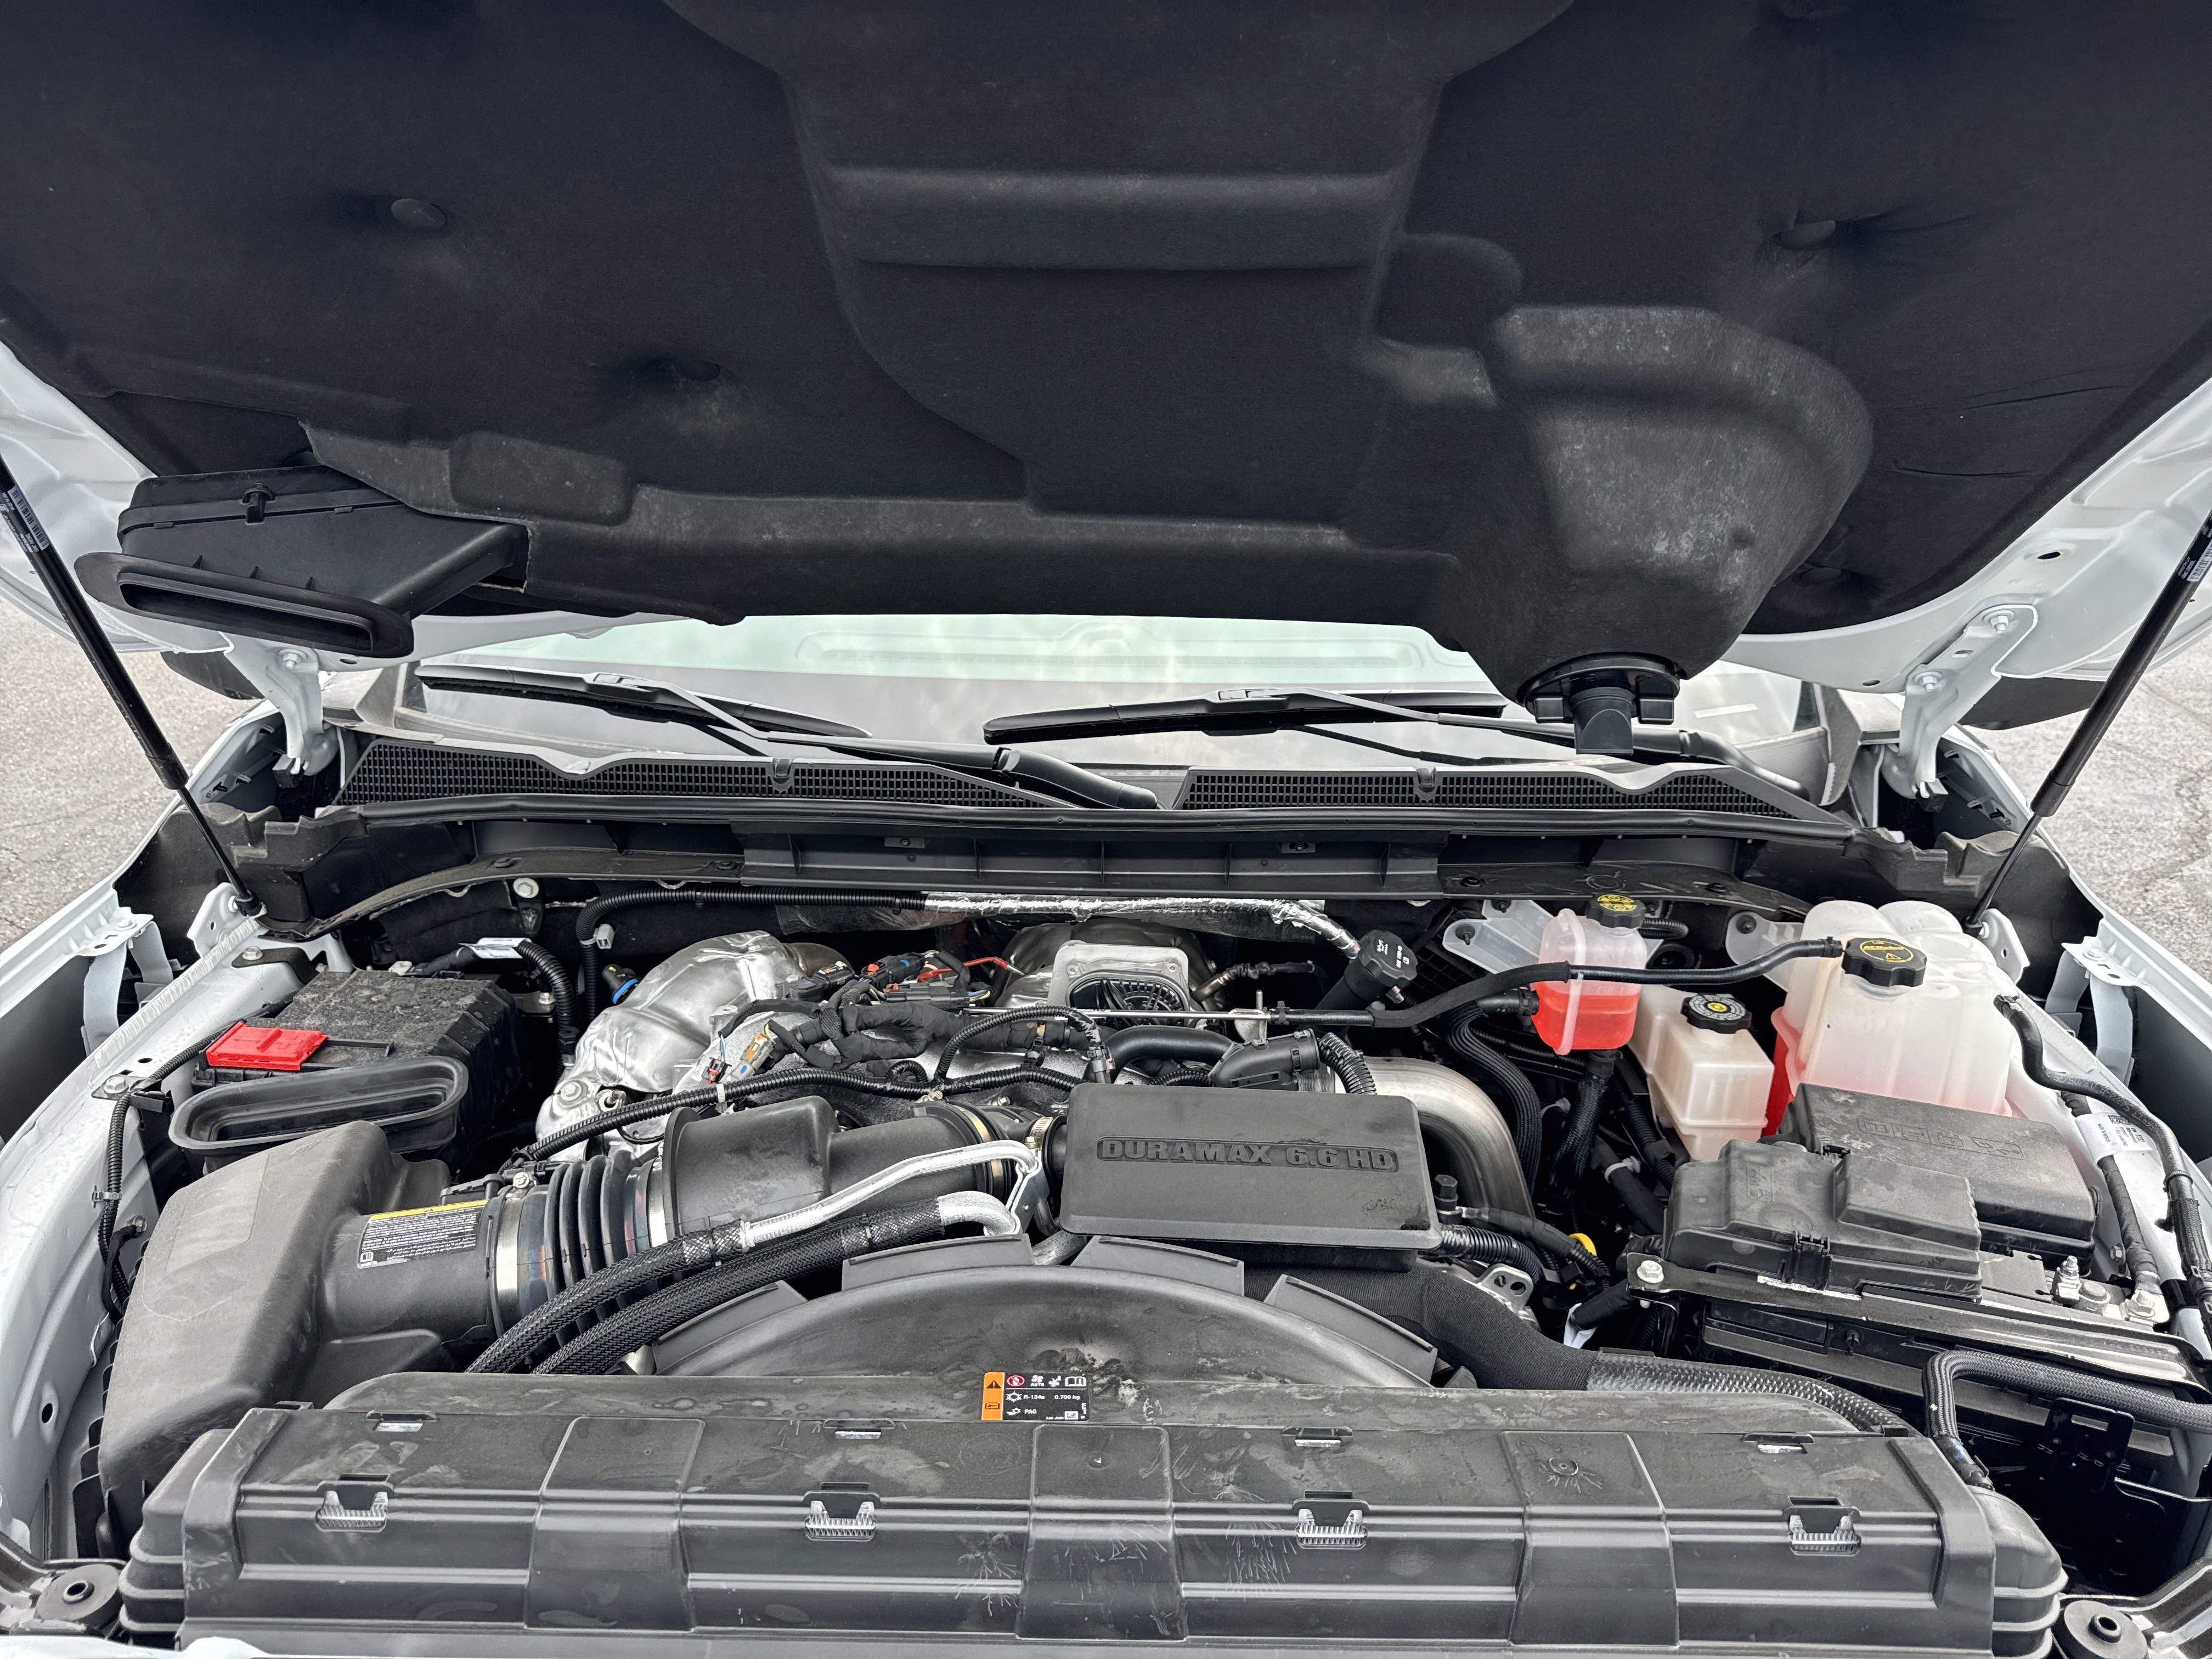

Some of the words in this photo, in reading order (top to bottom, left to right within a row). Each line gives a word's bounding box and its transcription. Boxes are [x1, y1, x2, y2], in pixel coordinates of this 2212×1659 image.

[1102, 1139, 1272, 1165] DURAMAX
[1286, 1144, 1339, 1167] 6.6
[1347, 1149, 1394, 1171] HD
